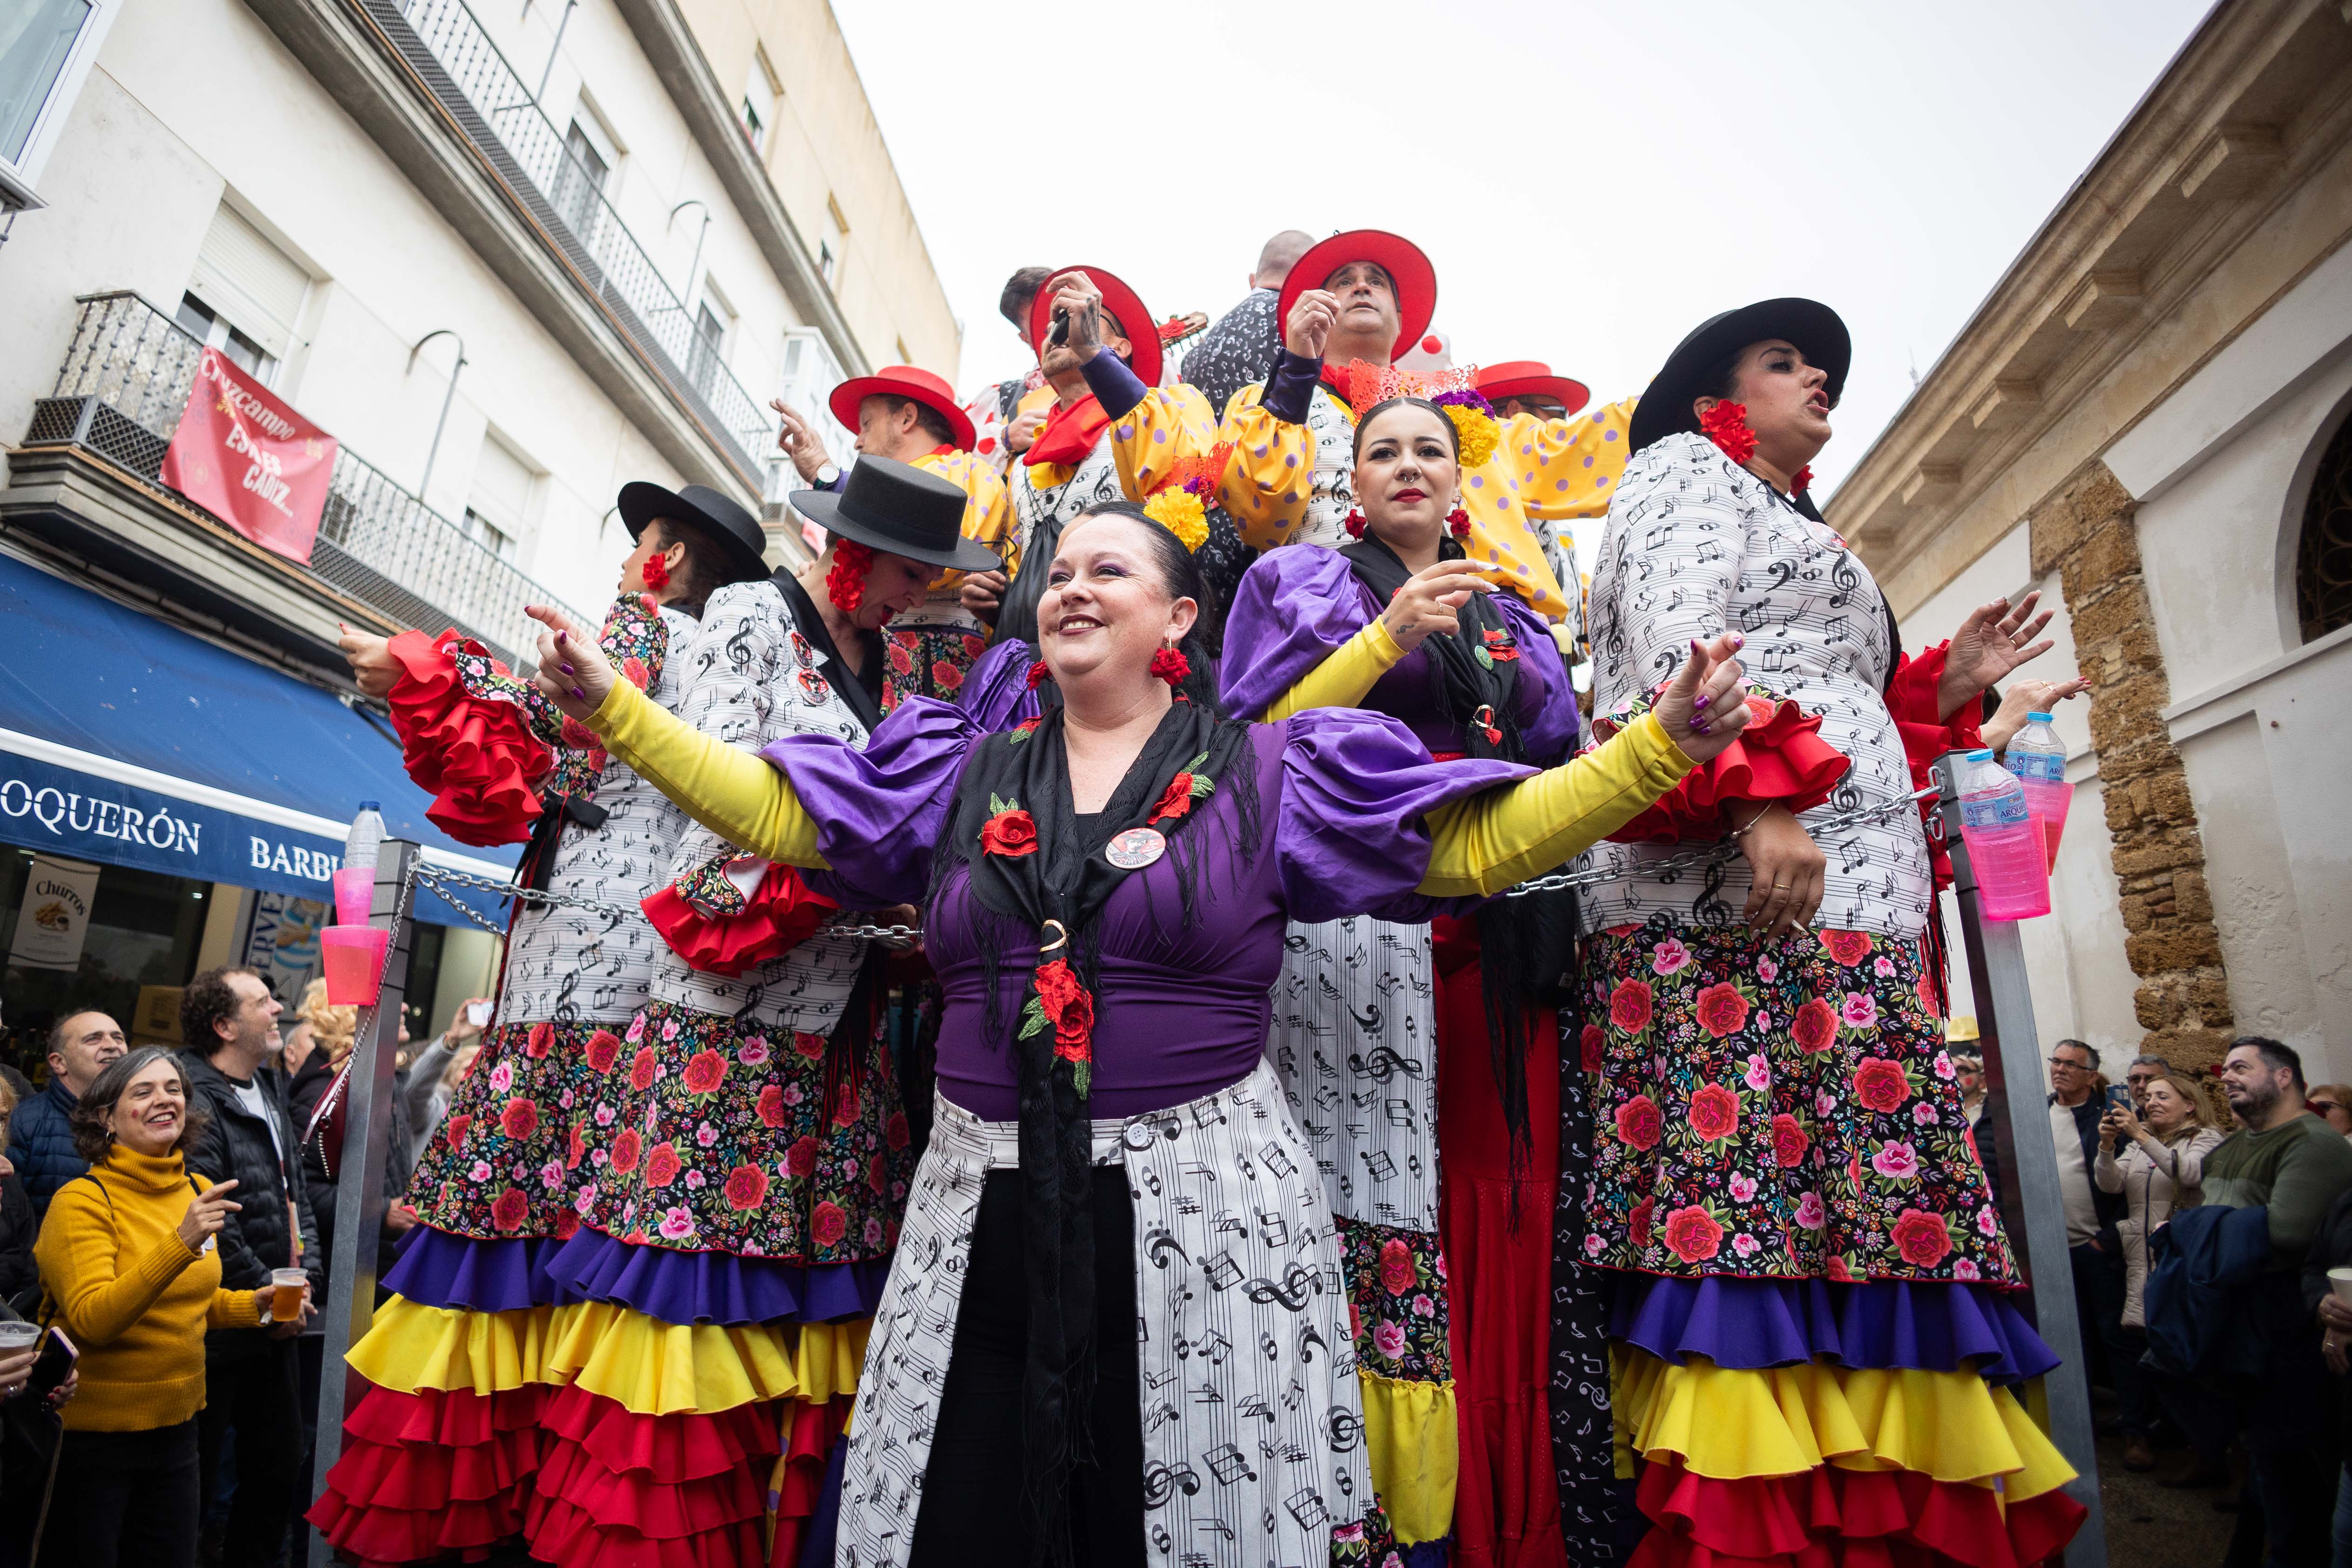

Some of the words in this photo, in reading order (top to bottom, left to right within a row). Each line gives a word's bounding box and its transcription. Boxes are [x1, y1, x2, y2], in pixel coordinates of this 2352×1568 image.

[200, 354, 296, 441] Cruzcampo
[0, 779, 202, 856] OQUERÓN
[36, 879, 86, 917] Churros
